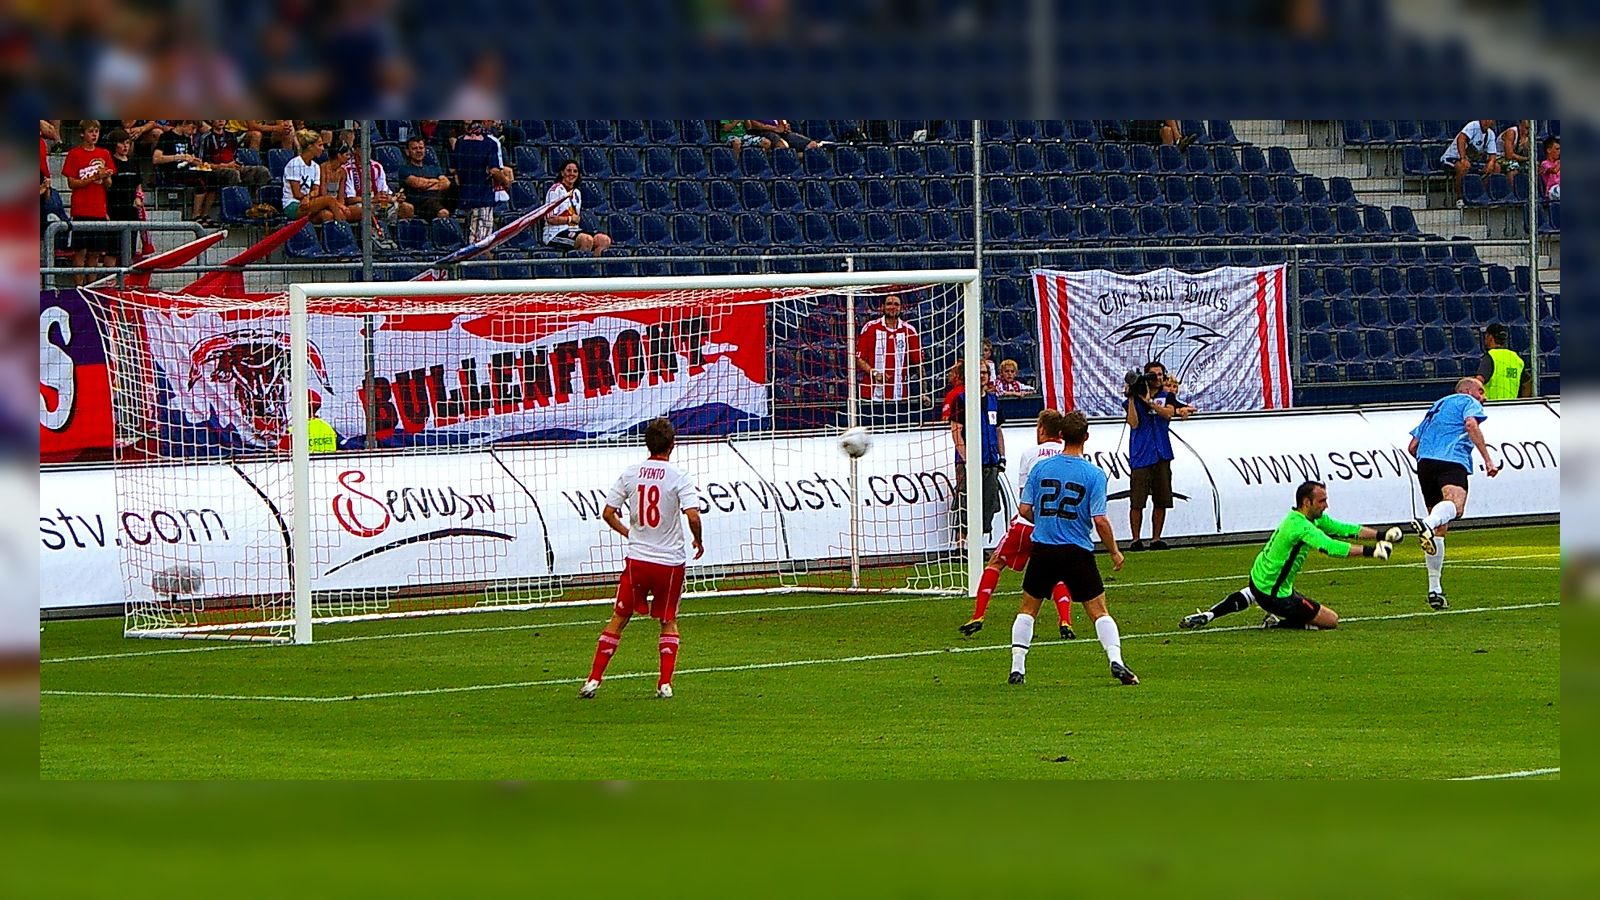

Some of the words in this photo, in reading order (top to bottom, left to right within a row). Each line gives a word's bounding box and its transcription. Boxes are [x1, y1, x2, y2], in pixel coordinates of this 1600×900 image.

[1097, 290, 1130, 315] The
[1136, 280, 1175, 304] Real
[1183, 280, 1229, 312] Bulls
[357, 316, 711, 441] BULLENFRONT
[638, 466, 666, 480] SVENTO
[561, 471, 958, 521] w.servustv.com
[637, 484, 661, 528] 18
[1040, 478, 1087, 520] 22
[40, 507, 230, 550] stv.com
